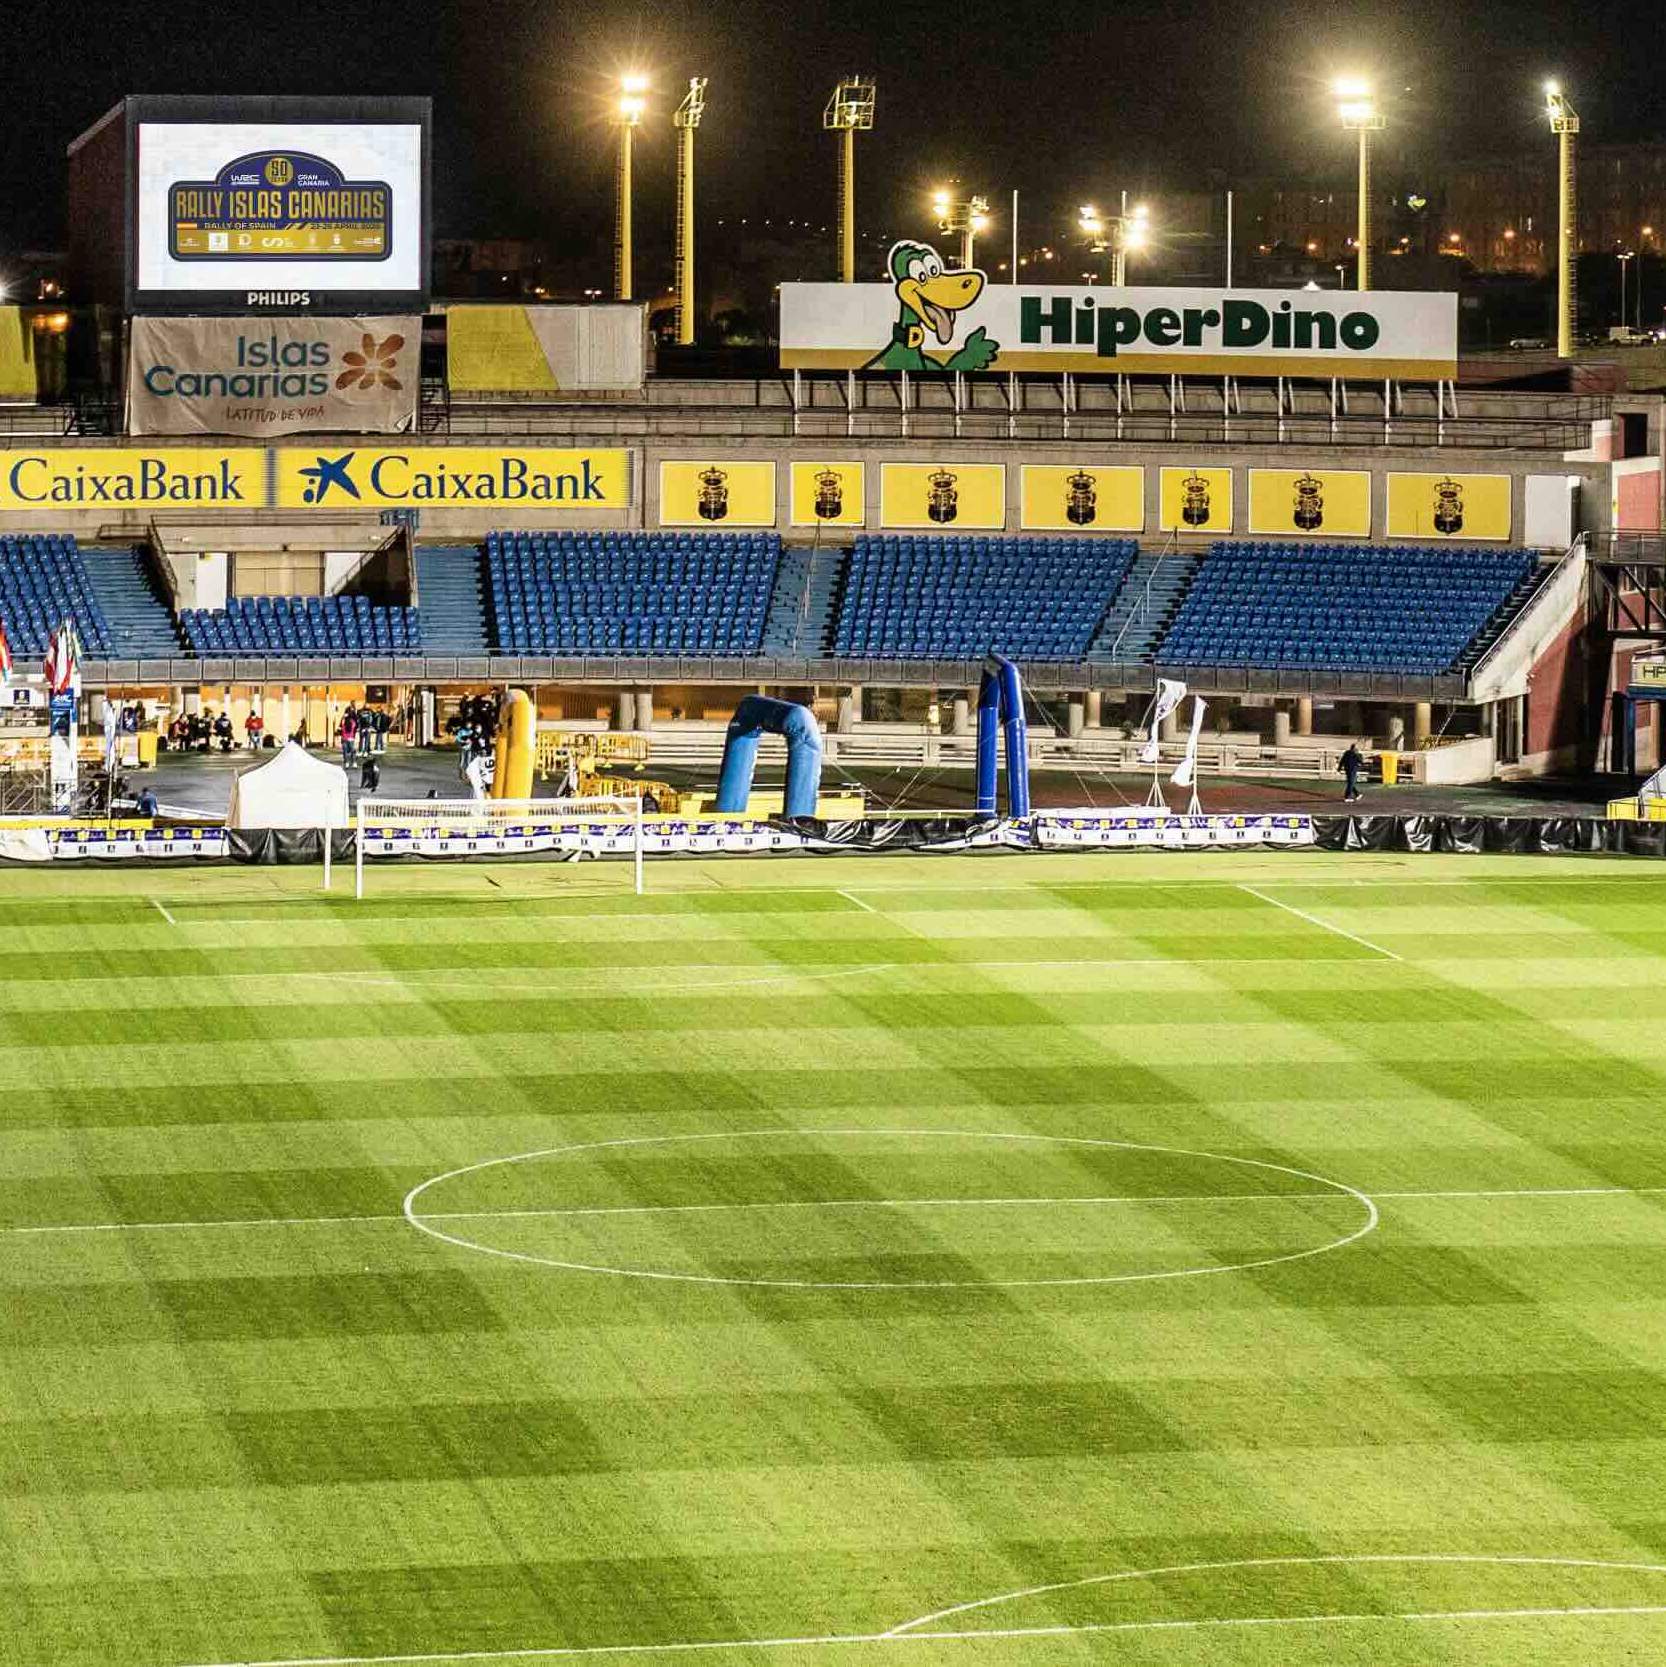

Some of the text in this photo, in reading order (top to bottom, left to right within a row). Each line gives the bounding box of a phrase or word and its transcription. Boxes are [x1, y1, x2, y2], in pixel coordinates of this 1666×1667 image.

[176, 190, 384, 219] RALLY ISLAS CANARIAS
[247, 292, 310, 306] PHILIPS
[1020, 296, 1380, 358] HiperDino
[238, 334, 330, 367] Islas
[144, 365, 329, 397] Canarias
[226, 405, 325, 422] LATITUD DE VIDA
[10, 458, 244, 502] CaixaBank
[371, 455, 606, 502] CaixaBank
